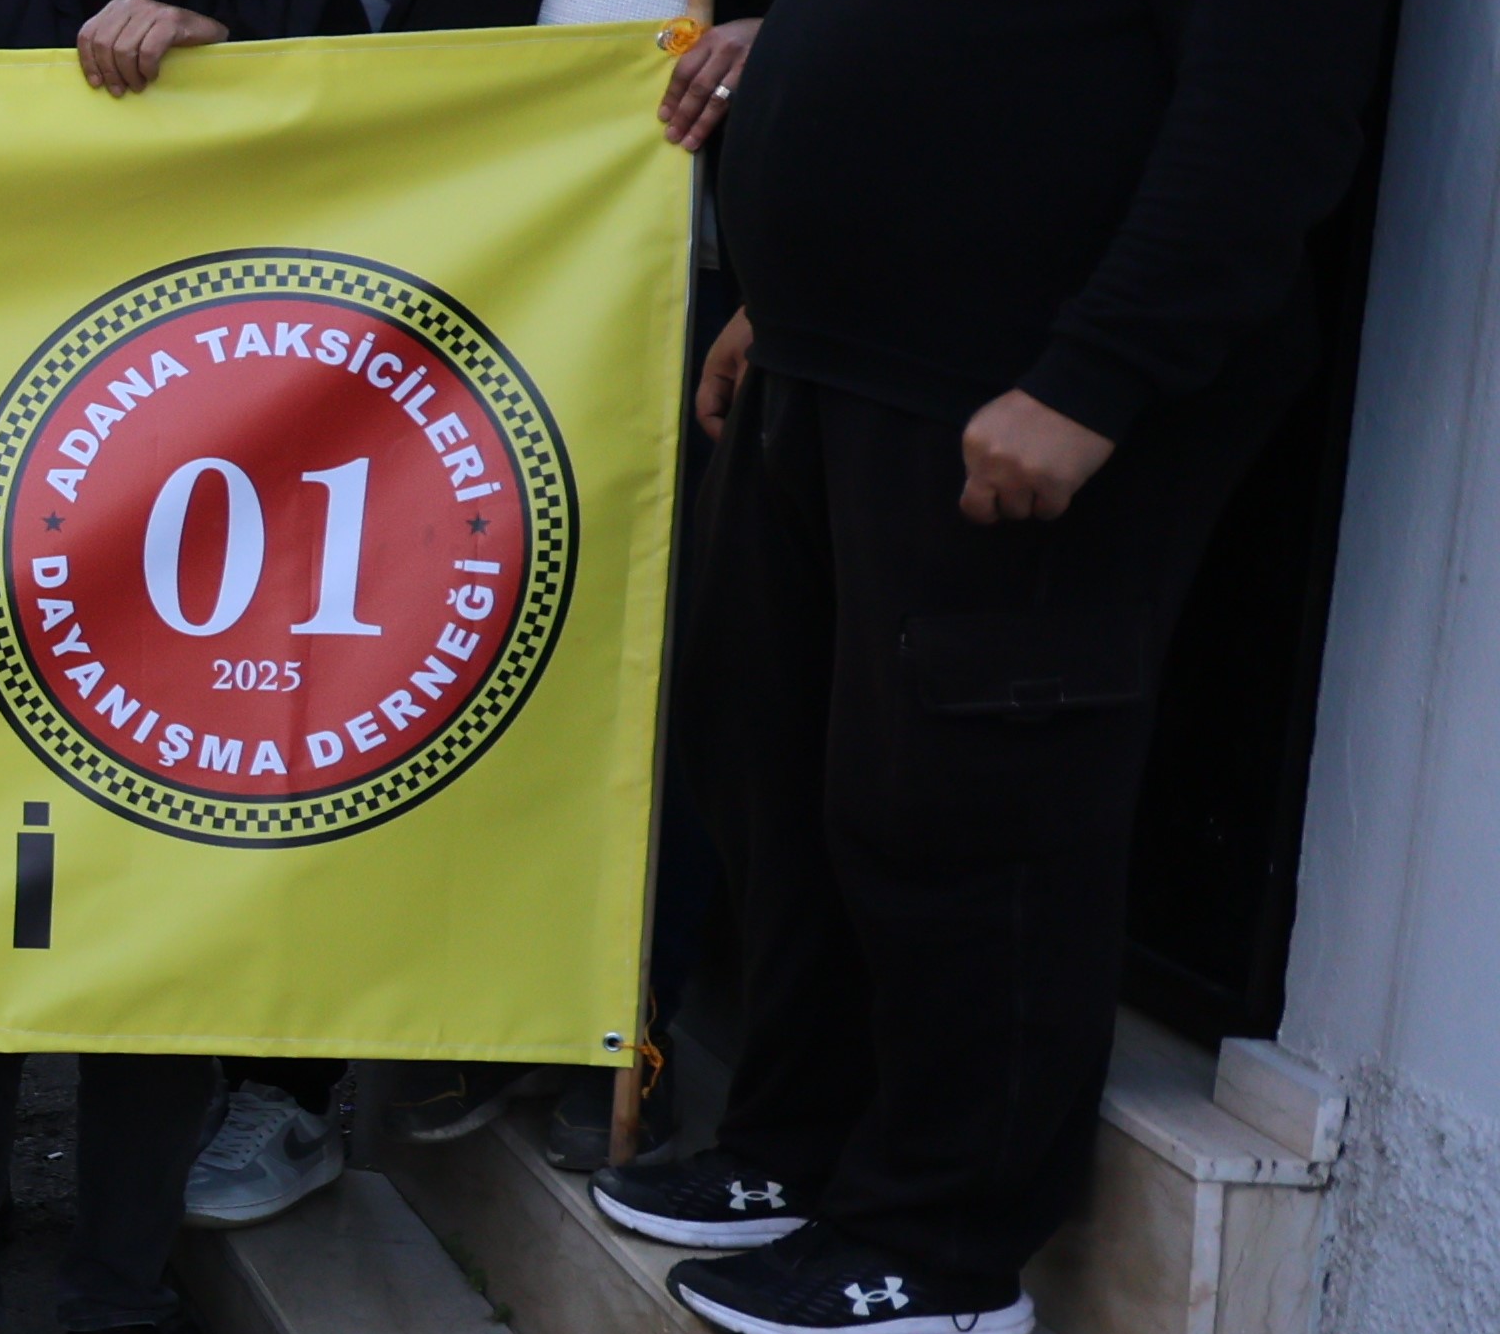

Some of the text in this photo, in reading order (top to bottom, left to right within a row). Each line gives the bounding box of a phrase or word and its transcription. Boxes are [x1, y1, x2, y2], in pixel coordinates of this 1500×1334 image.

[45, 322, 502, 504] ADANA TAKSİCİLERİ
[144, 457, 382, 637] 01
[31, 555, 501, 776] DAYANIŞMA DERNEĞİ
[212, 659, 302, 692] 2025
